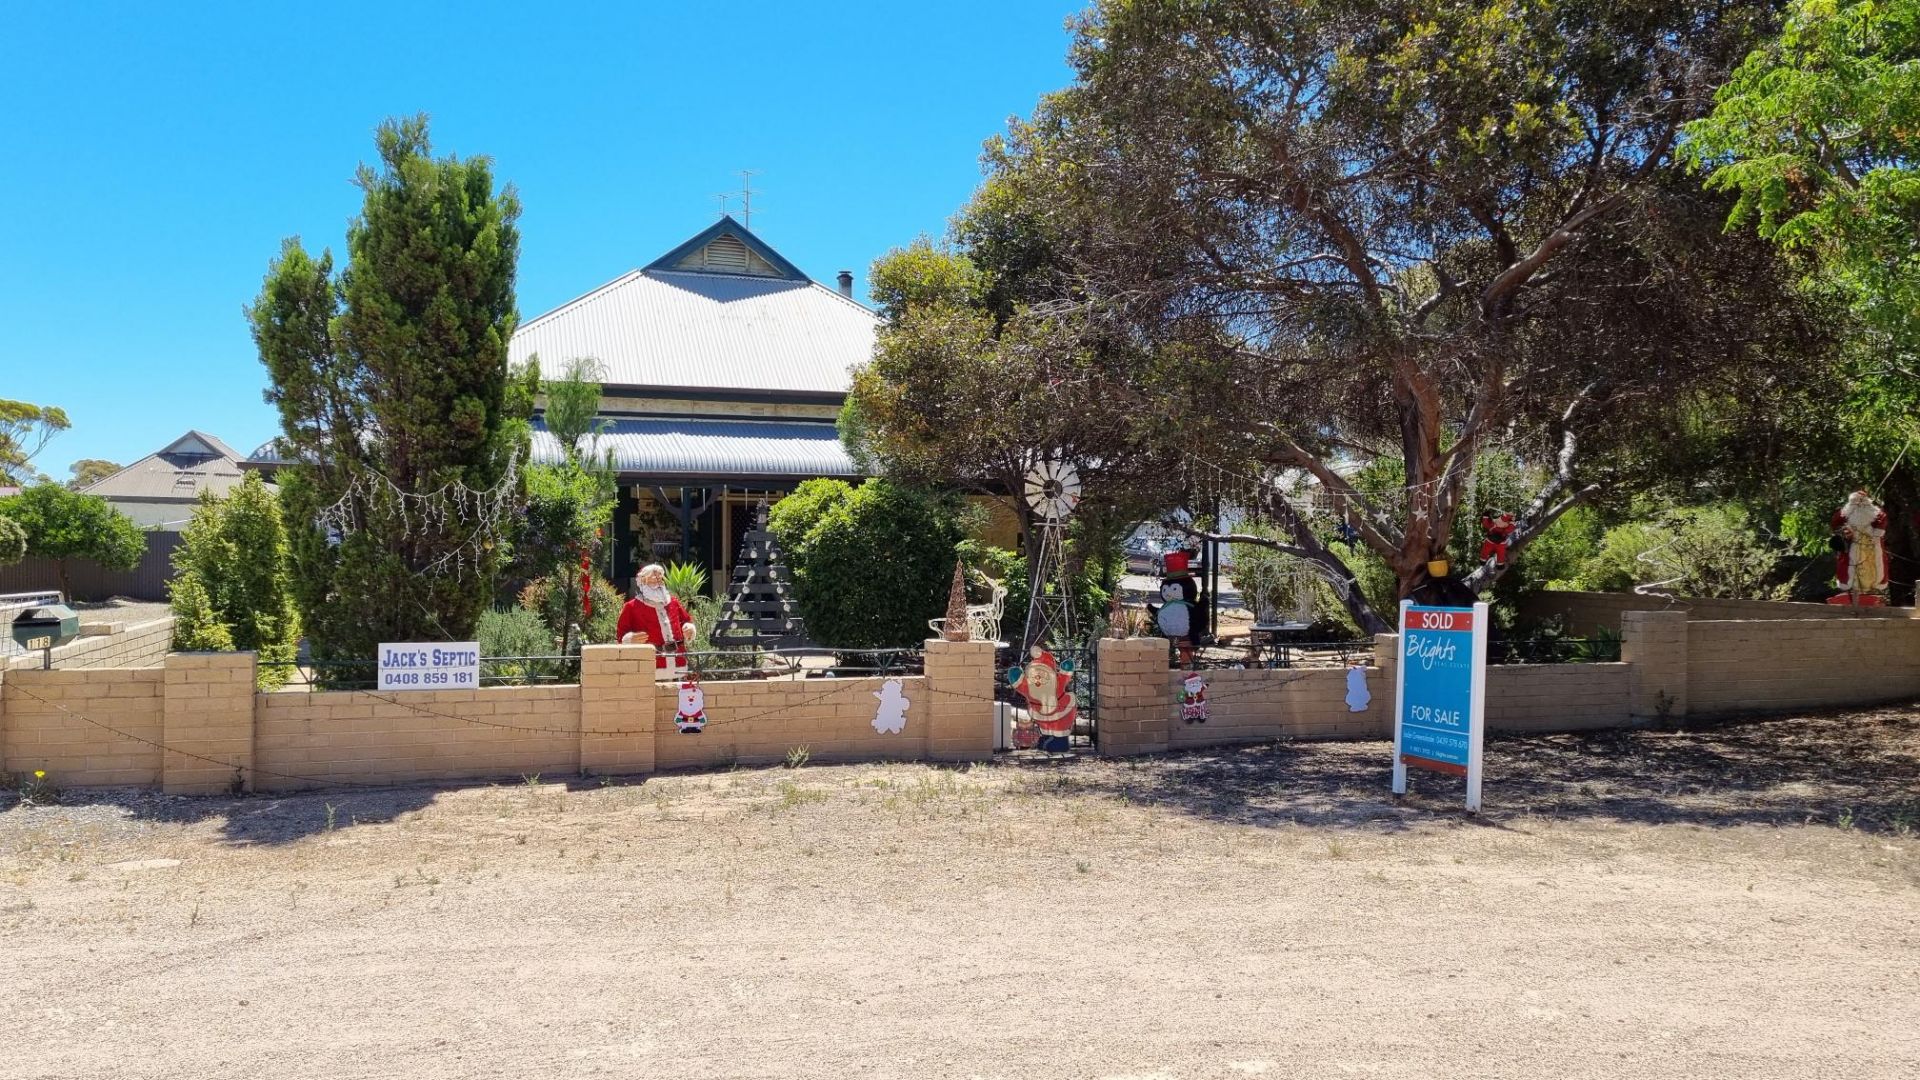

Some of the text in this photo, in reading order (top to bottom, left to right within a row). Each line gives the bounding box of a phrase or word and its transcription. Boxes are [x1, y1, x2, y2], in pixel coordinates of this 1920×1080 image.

[1422, 612, 1453, 629] SOLD
[30, 637, 49, 649] 118
[382, 648, 476, 667] JACK'S SEPTIC
[1406, 634, 1456, 671] Blights
[385, 672, 473, 685] 0408 859 181
[1411, 705, 1460, 726] FOR SALE
